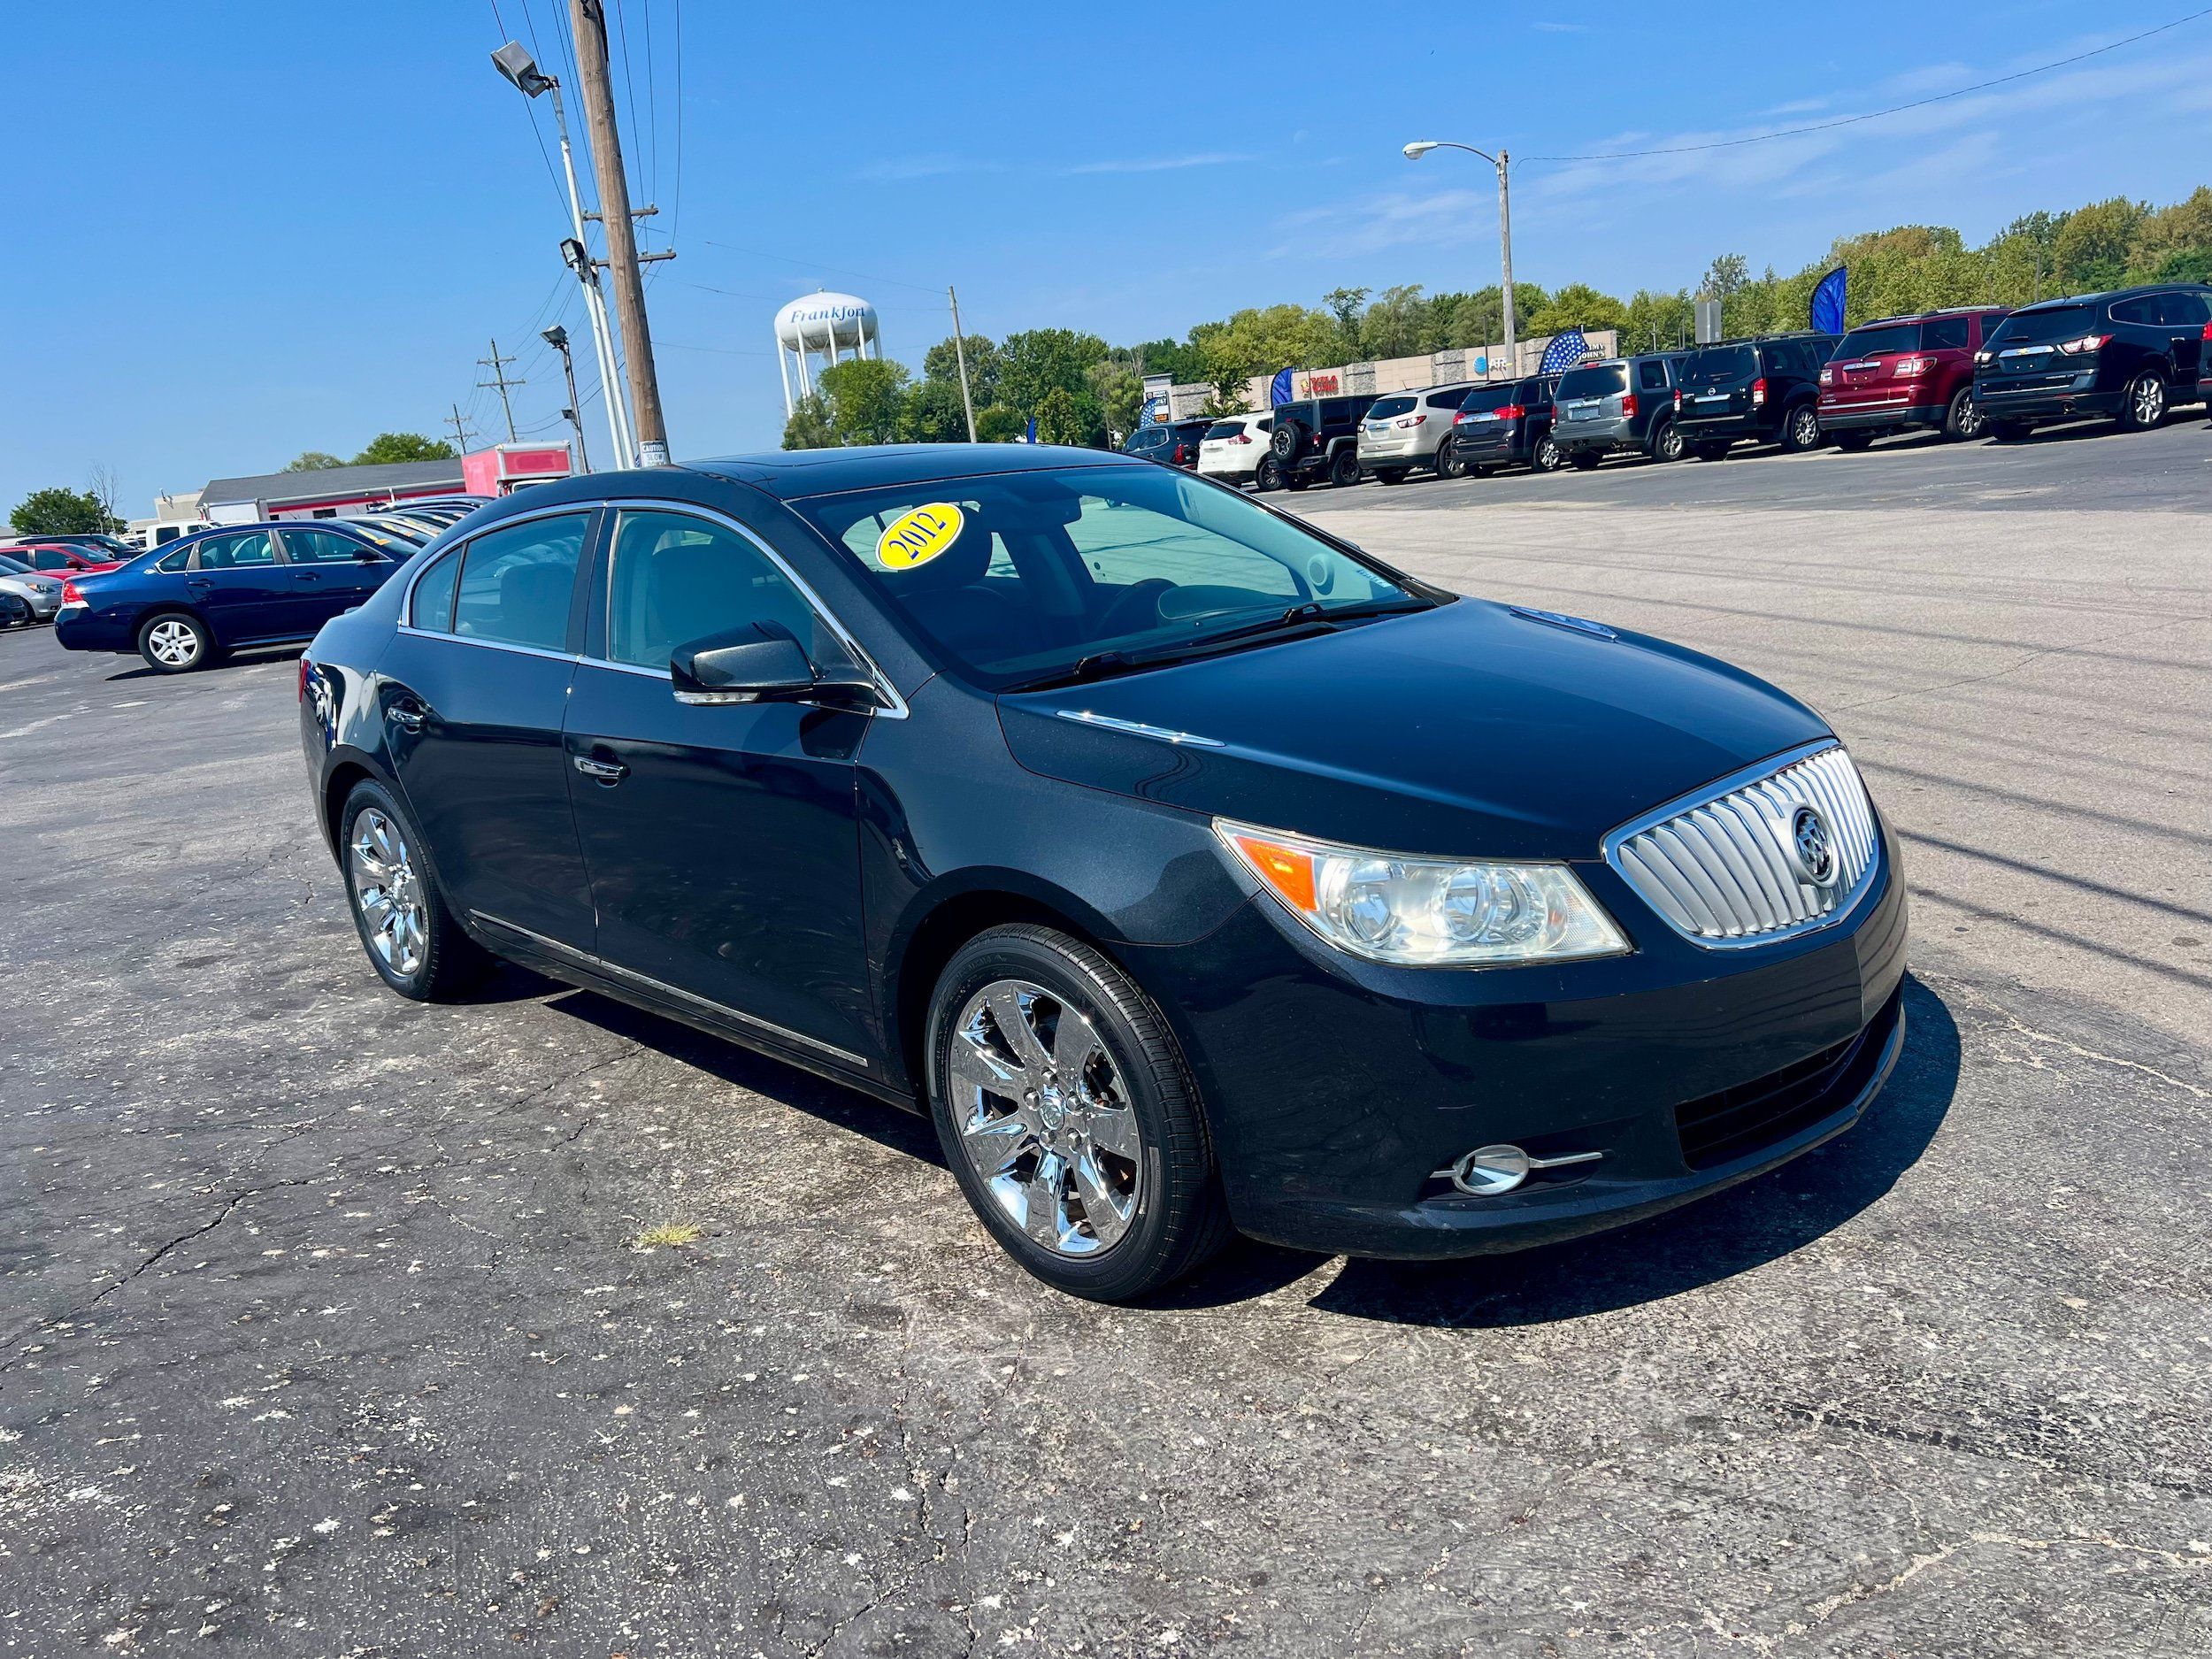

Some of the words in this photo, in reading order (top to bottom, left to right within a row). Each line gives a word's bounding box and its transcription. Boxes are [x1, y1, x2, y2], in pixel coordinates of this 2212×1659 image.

[790, 305, 865, 324] Frankfort
[641, 443, 665, 452] CAUTION
[888, 511, 947, 560] 2012
